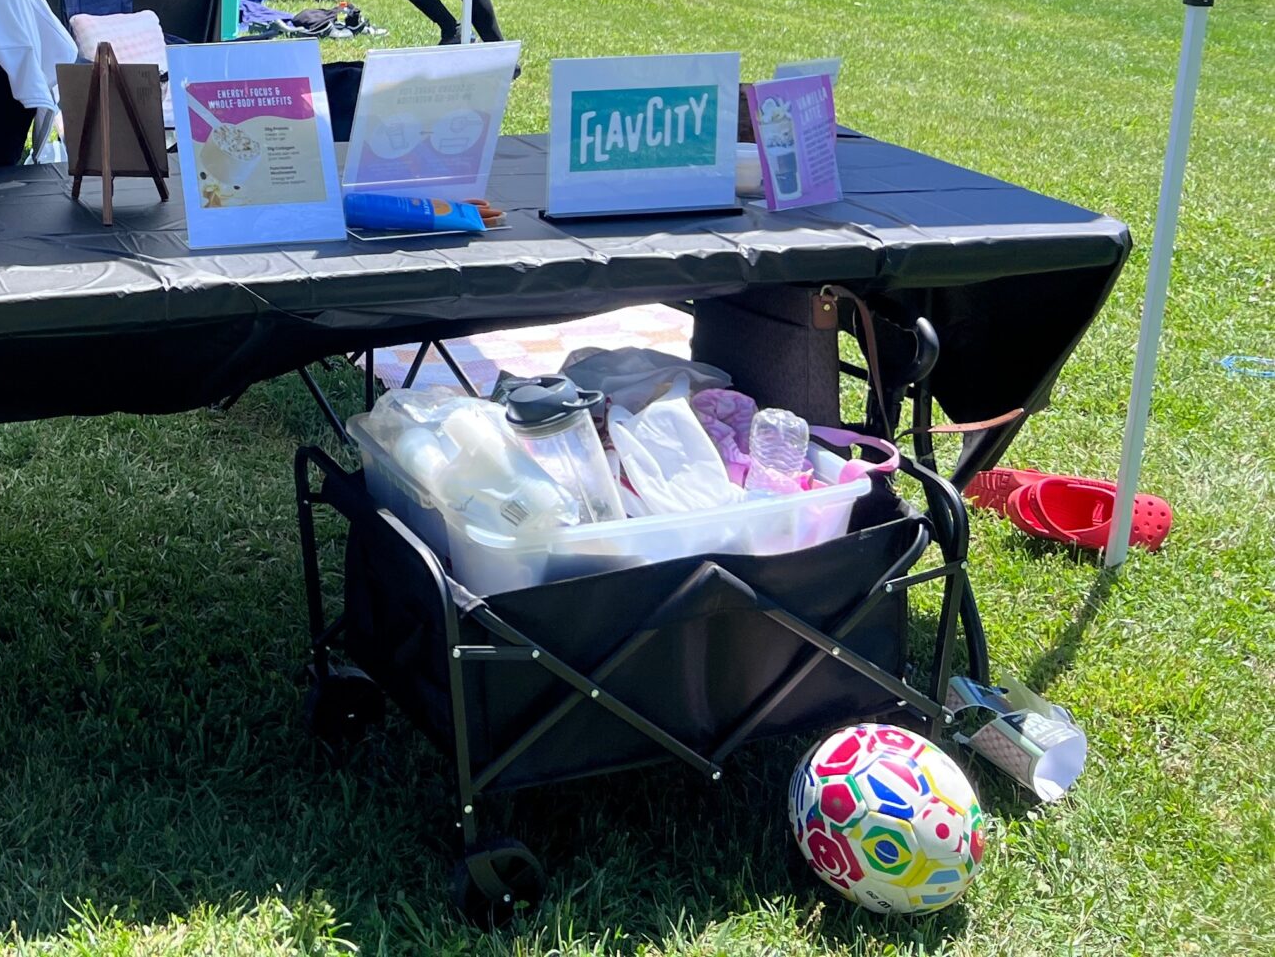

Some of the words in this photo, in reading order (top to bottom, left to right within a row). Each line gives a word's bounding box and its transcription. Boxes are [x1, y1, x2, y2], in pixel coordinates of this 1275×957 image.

[217, 88, 248, 99] ENERGY,
[250, 87, 273, 97] FOCUS
[274, 87, 280, 96] &
[795, 86, 828, 111] VANILLA
[208, 98, 255, 110] WHOLE-BODY
[257, 96, 293, 107] BENEFITS
[798, 105, 822, 126] LATTE
